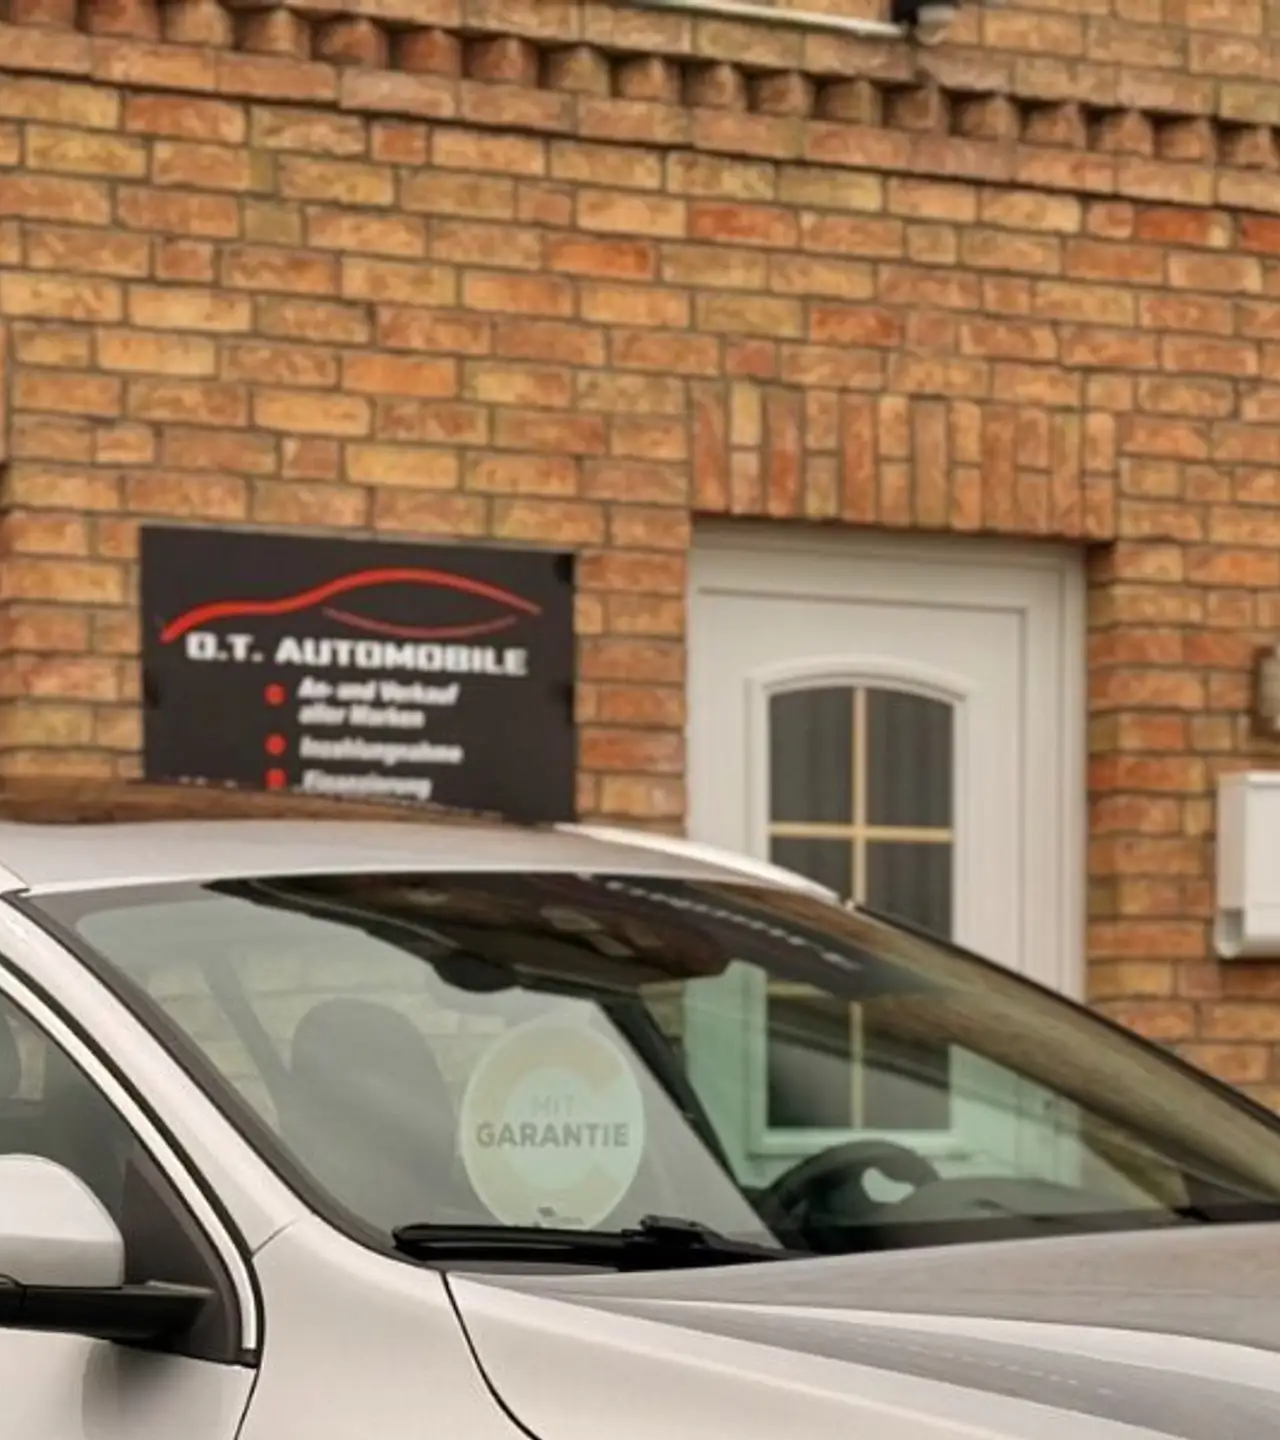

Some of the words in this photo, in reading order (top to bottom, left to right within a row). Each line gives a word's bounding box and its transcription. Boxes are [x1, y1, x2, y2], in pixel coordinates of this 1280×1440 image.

[185, 632, 263, 662] O.T.
[274, 636, 528, 676] AUTOMOBILE
[530, 1094, 576, 1118] MIT
[475, 1121, 630, 1149] GARANTIE
